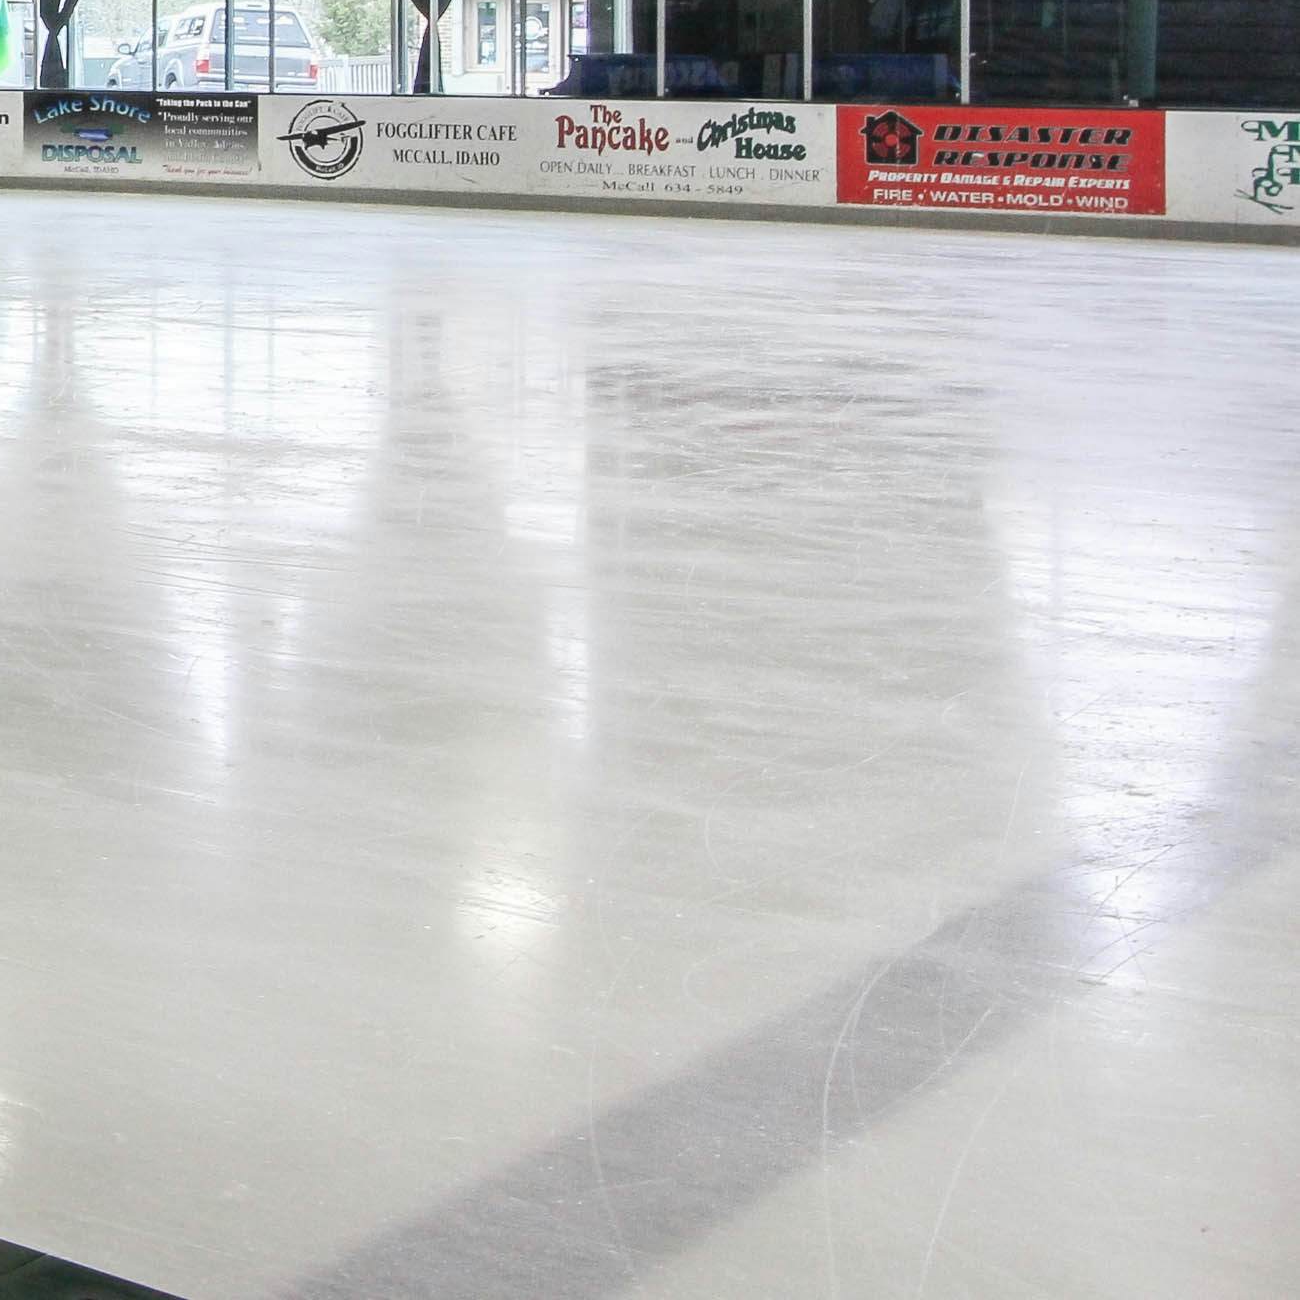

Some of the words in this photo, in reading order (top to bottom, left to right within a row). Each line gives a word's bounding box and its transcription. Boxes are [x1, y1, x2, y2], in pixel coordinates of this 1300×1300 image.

[33, 98, 83, 124] Lake
[89, 95, 152, 124] Shore
[589, 104, 622, 126] The
[164, 124, 187, 135] local
[377, 123, 473, 141] FOGGLIFTER
[477, 124, 517, 142] CAFE
[555, 114, 670, 156] Pancake
[697, 107, 797, 151] Christmas
[932, 124, 1132, 146] DISASTER
[41, 144, 143, 164] DISPOSAL
[456, 150, 500, 166] IDAHO
[734, 137, 808, 161] House
[932, 149, 1131, 172] RESPONSE
[539, 161, 573, 174] OPEN
[628, 164, 697, 178] BREAKFAST
[709, 165, 755, 179] LUNCH
[769, 167, 820, 182] DINNER
[868, 170, 938, 184] PROPERTY
[940, 172, 1000, 186] DAMAGE
[1013, 175, 1066, 188] REPAIR
[1068, 176, 1130, 190] EXPERTS
[602, 181, 655, 193] McCall
[873, 188, 912, 201] FIRE
[930, 190, 994, 204] WATER
[1006, 192, 1063, 207] MOLD
[1075, 194, 1129, 209] WIND
